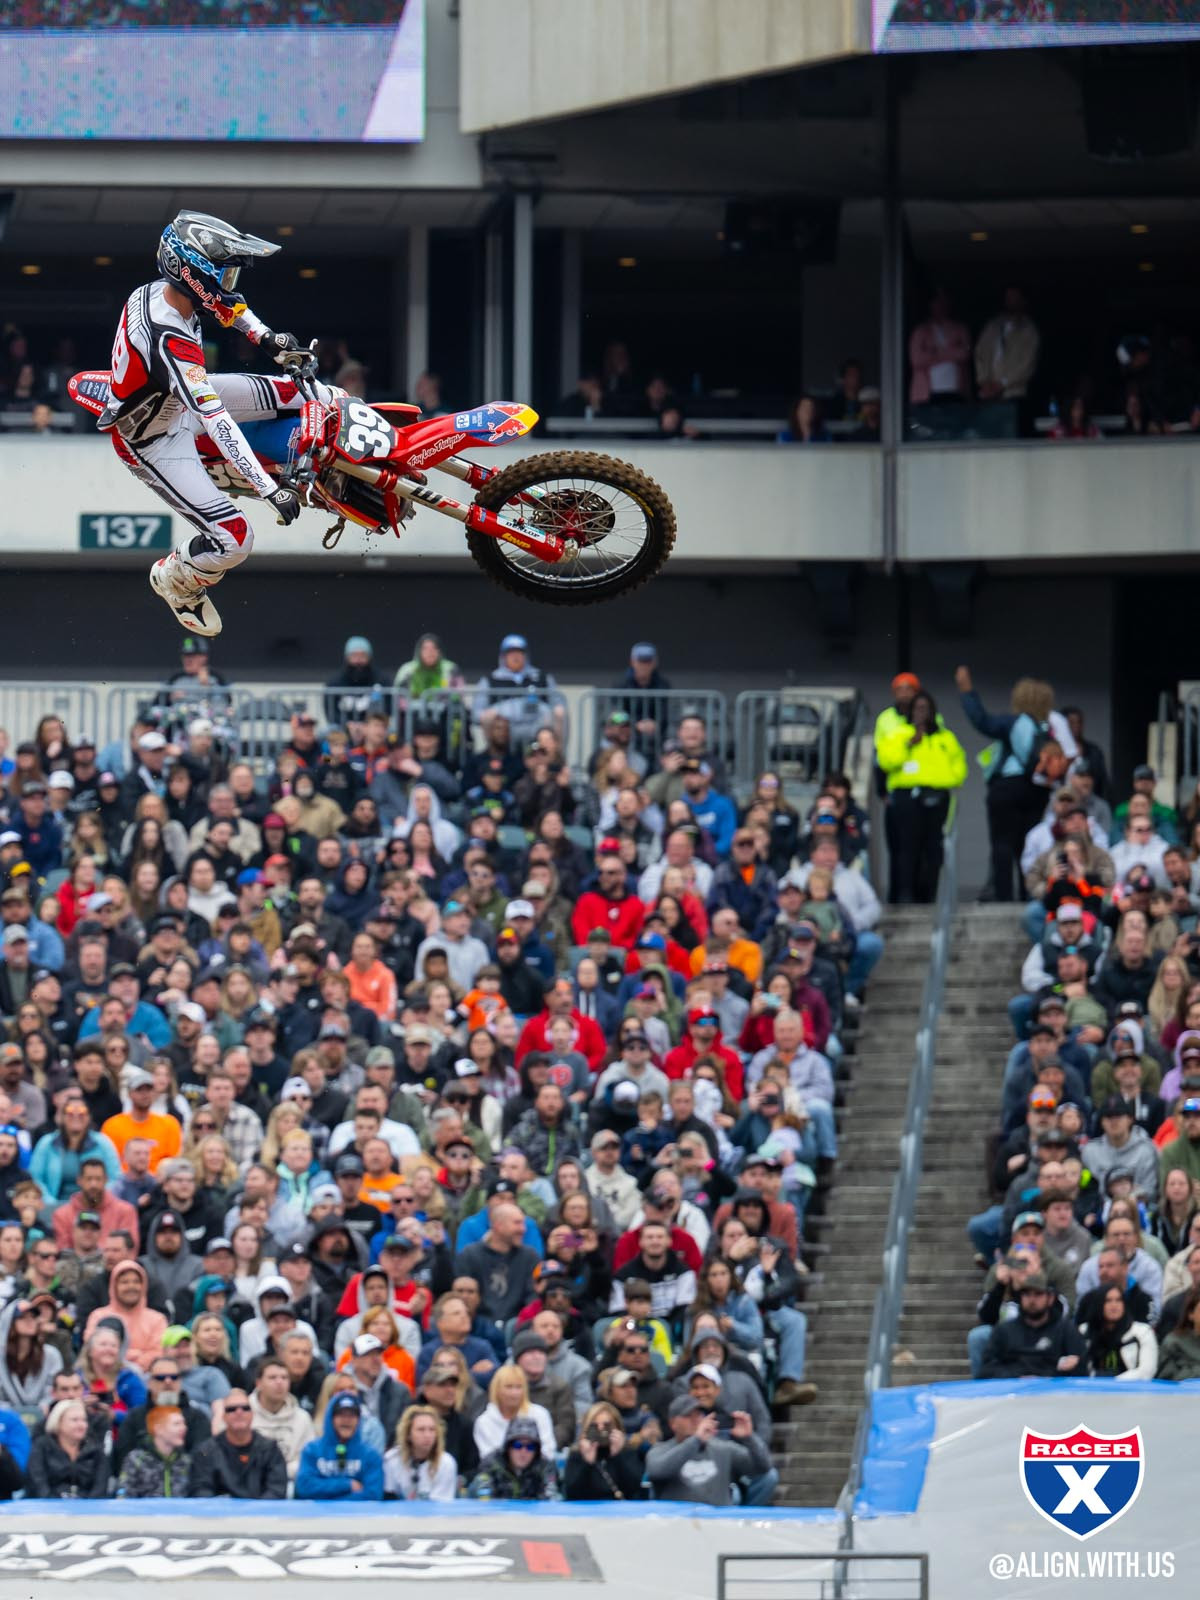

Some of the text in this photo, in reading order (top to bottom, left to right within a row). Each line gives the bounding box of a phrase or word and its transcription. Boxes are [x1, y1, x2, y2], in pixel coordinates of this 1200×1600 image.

[216, 419, 232, 441] Troy
[225, 440, 240, 460] Lee
[349, 402, 391, 458] 39
[407, 454, 424, 466] Troy
[422, 448, 437, 459] Lee
[90, 516, 161, 547] 137
